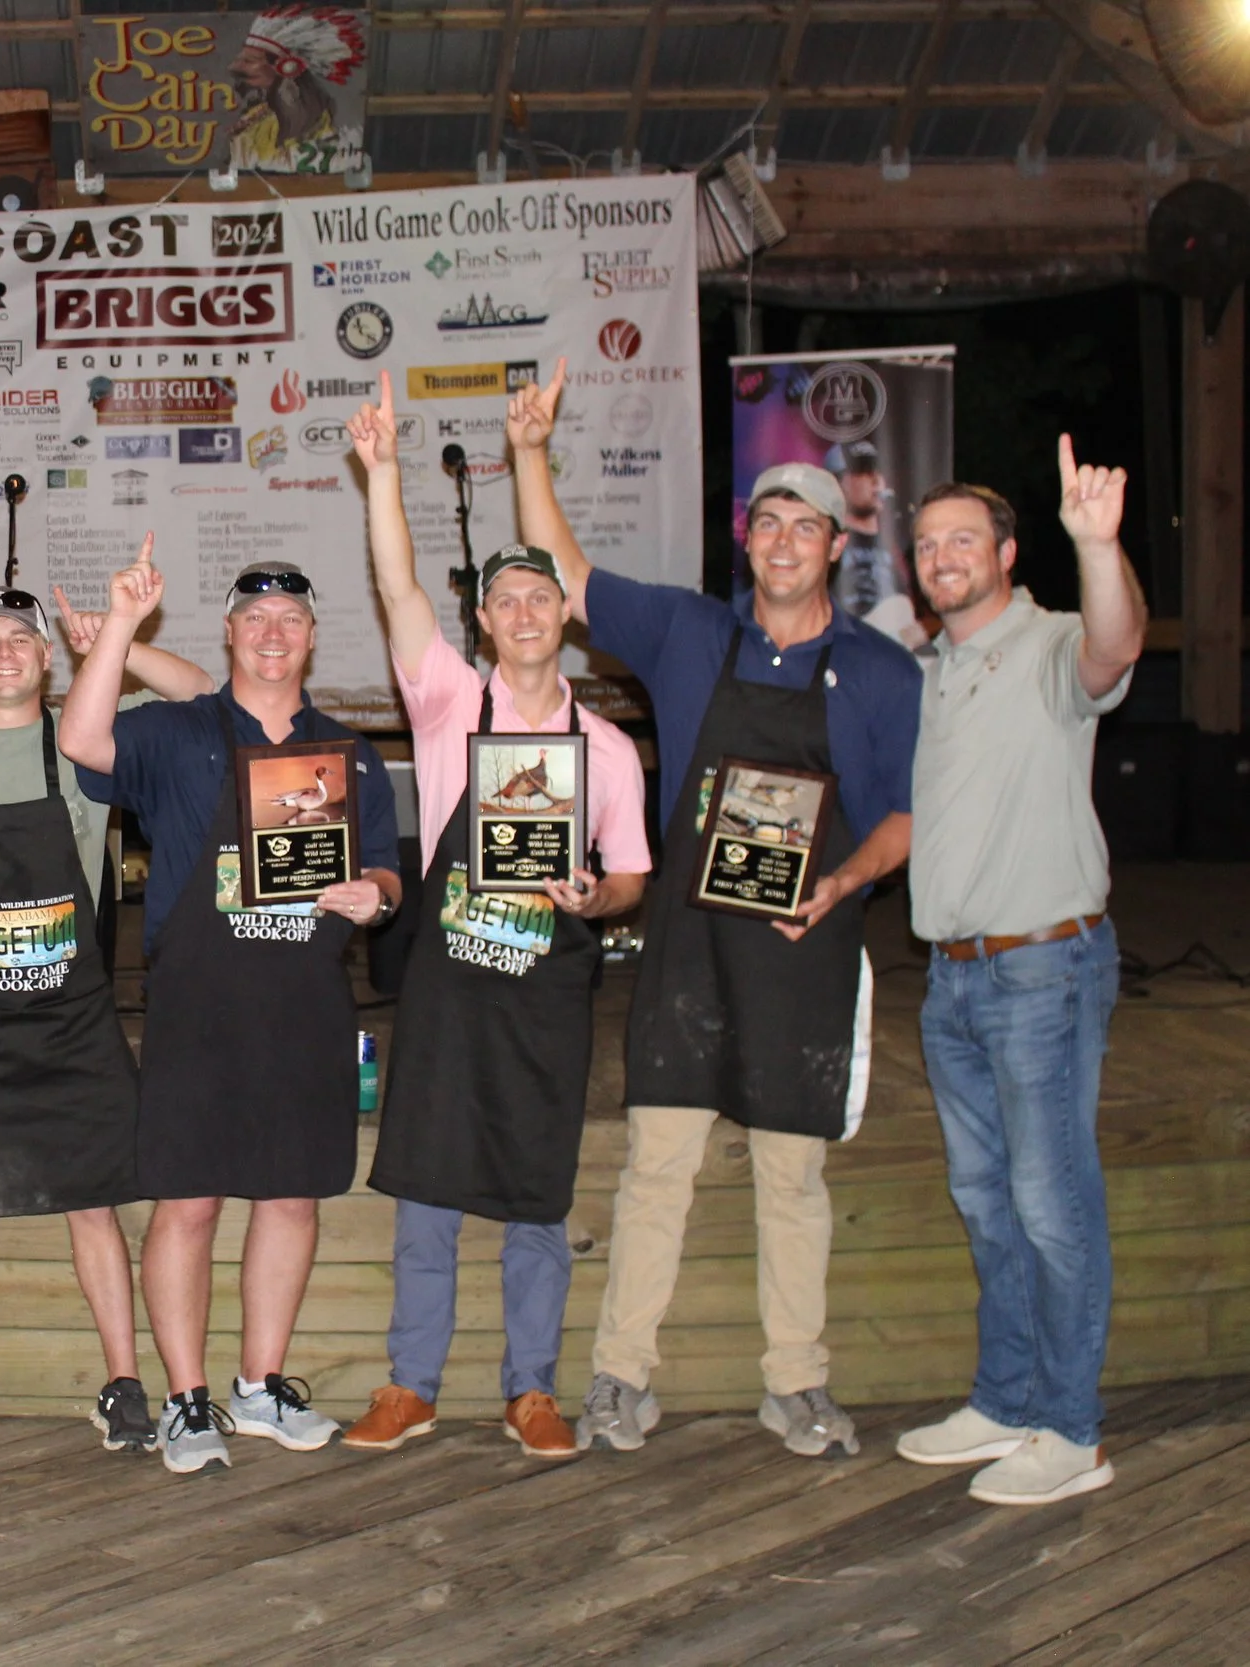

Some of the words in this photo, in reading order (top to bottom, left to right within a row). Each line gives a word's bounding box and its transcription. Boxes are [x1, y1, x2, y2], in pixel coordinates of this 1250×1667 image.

[92, 17, 216, 72] Joe
[88, 60, 237, 112] Cain
[91, 113, 217, 165] Day
[312, 205, 369, 245] Wild
[376, 205, 442, 242] Game
[448, 192, 561, 236] Cook-Off
[564, 192, 673, 240] Sponsors
[219, 222, 276, 246] 2024
[341, 259, 382, 271] FIRST
[341, 271, 411, 285] HORIZON
[54, 283, 276, 330] BRIGGS
[57, 350, 276, 369] EQUIPMENT
[424, 372, 498, 390] Thompson
[620, 366, 687, 383] CREEK
[113, 381, 217, 401] BLUEGILL
[306, 377, 376, 398] Hiller
[3, 406, 60, 417] SOLUTIONS
[305, 426, 346, 442] GCT
[496, 863, 516, 872] BEST
[518, 863, 555, 872] OVERALL
[273, 875, 288, 883] BEST
[290, 871, 336, 882] PRESENTATION
[0, 901, 36, 910] WILDLIFE
[37, 893, 75, 906] FEDERATION
[0, 909, 58, 922] ALABAMA
[228, 914, 273, 928] WILD
[276, 915, 317, 931] GAME
[234, 926, 312, 942] COOK-OFF
[446, 931, 486, 951] WILD
[489, 942, 536, 967] GAME
[27, 961, 70, 979] GAME
[448, 946, 528, 977] COOK-OFF
